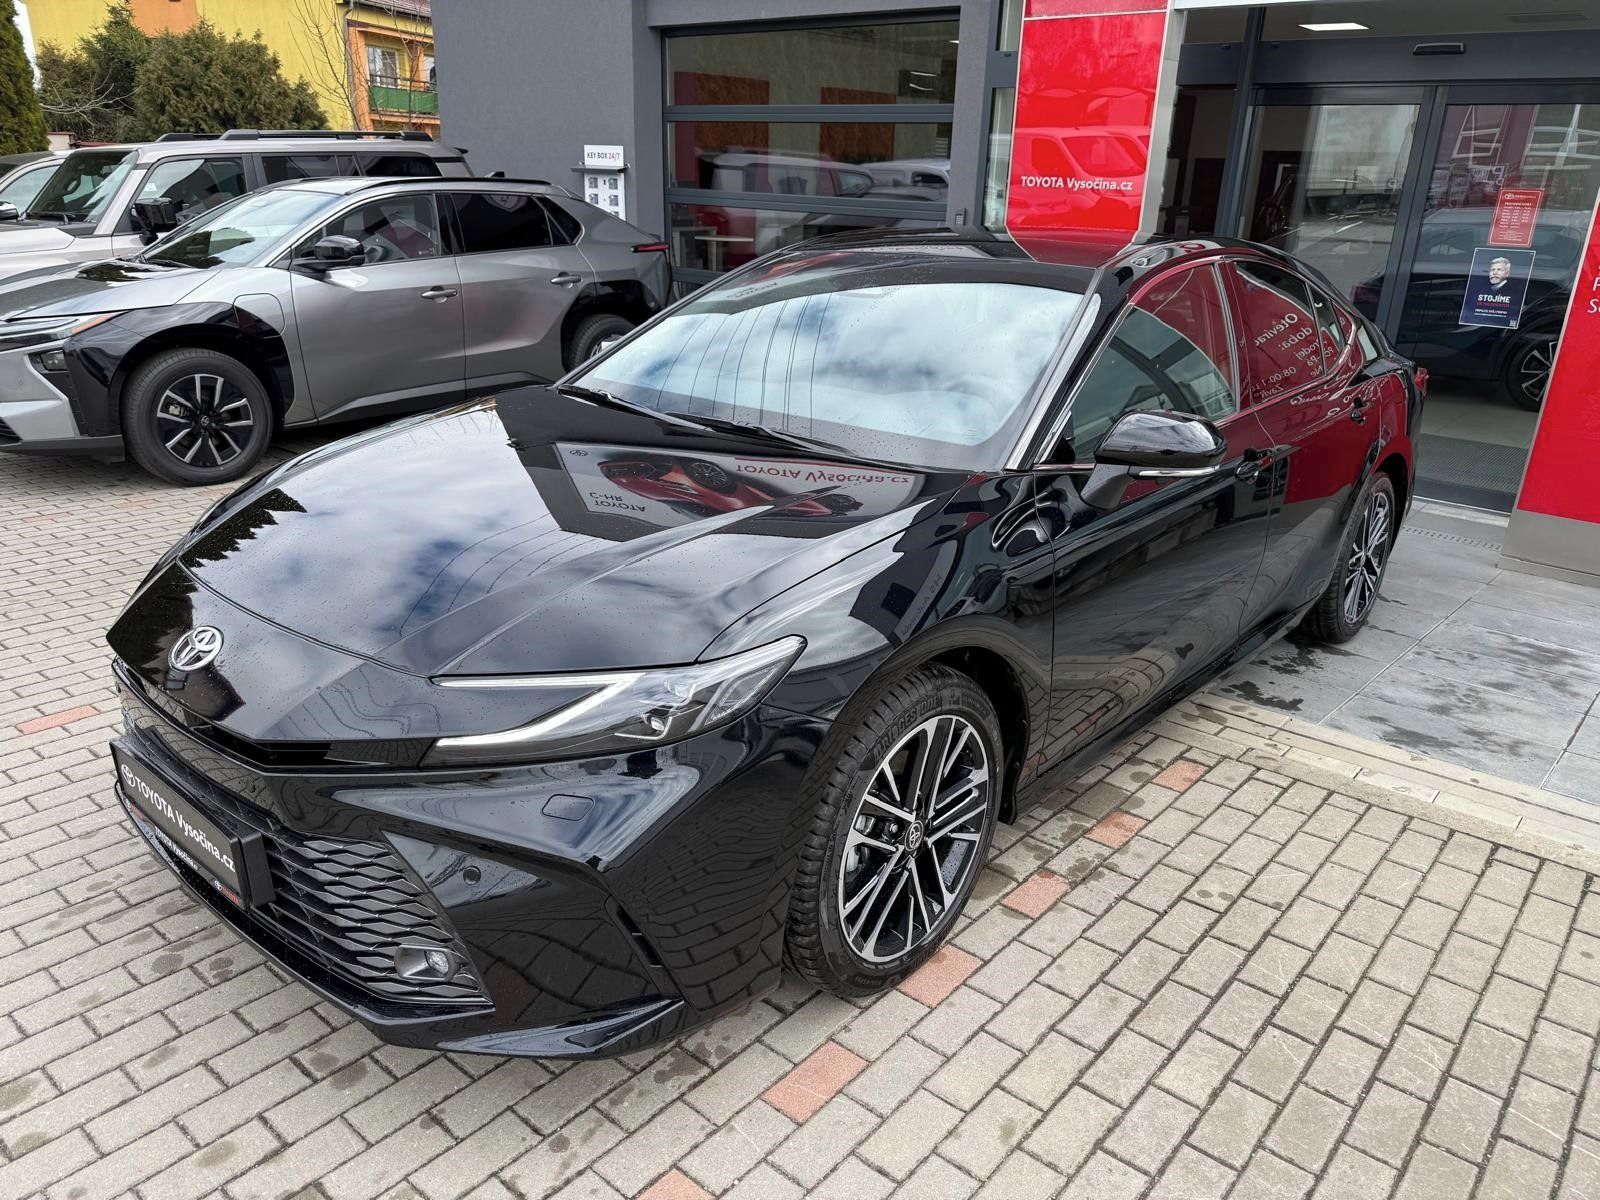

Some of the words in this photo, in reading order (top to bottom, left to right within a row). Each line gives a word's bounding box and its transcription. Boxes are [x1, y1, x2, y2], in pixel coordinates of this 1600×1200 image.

[608, 152, 620, 160] 24/7
[1020, 176, 1064, 188] TOYOTA
[1066, 178, 1133, 191] Vysočina.cz
[1477, 294, 1511, 303] STOJÍME
[134, 776, 176, 823] TOYOTA
[175, 810, 236, 873] Vysočina.cz
